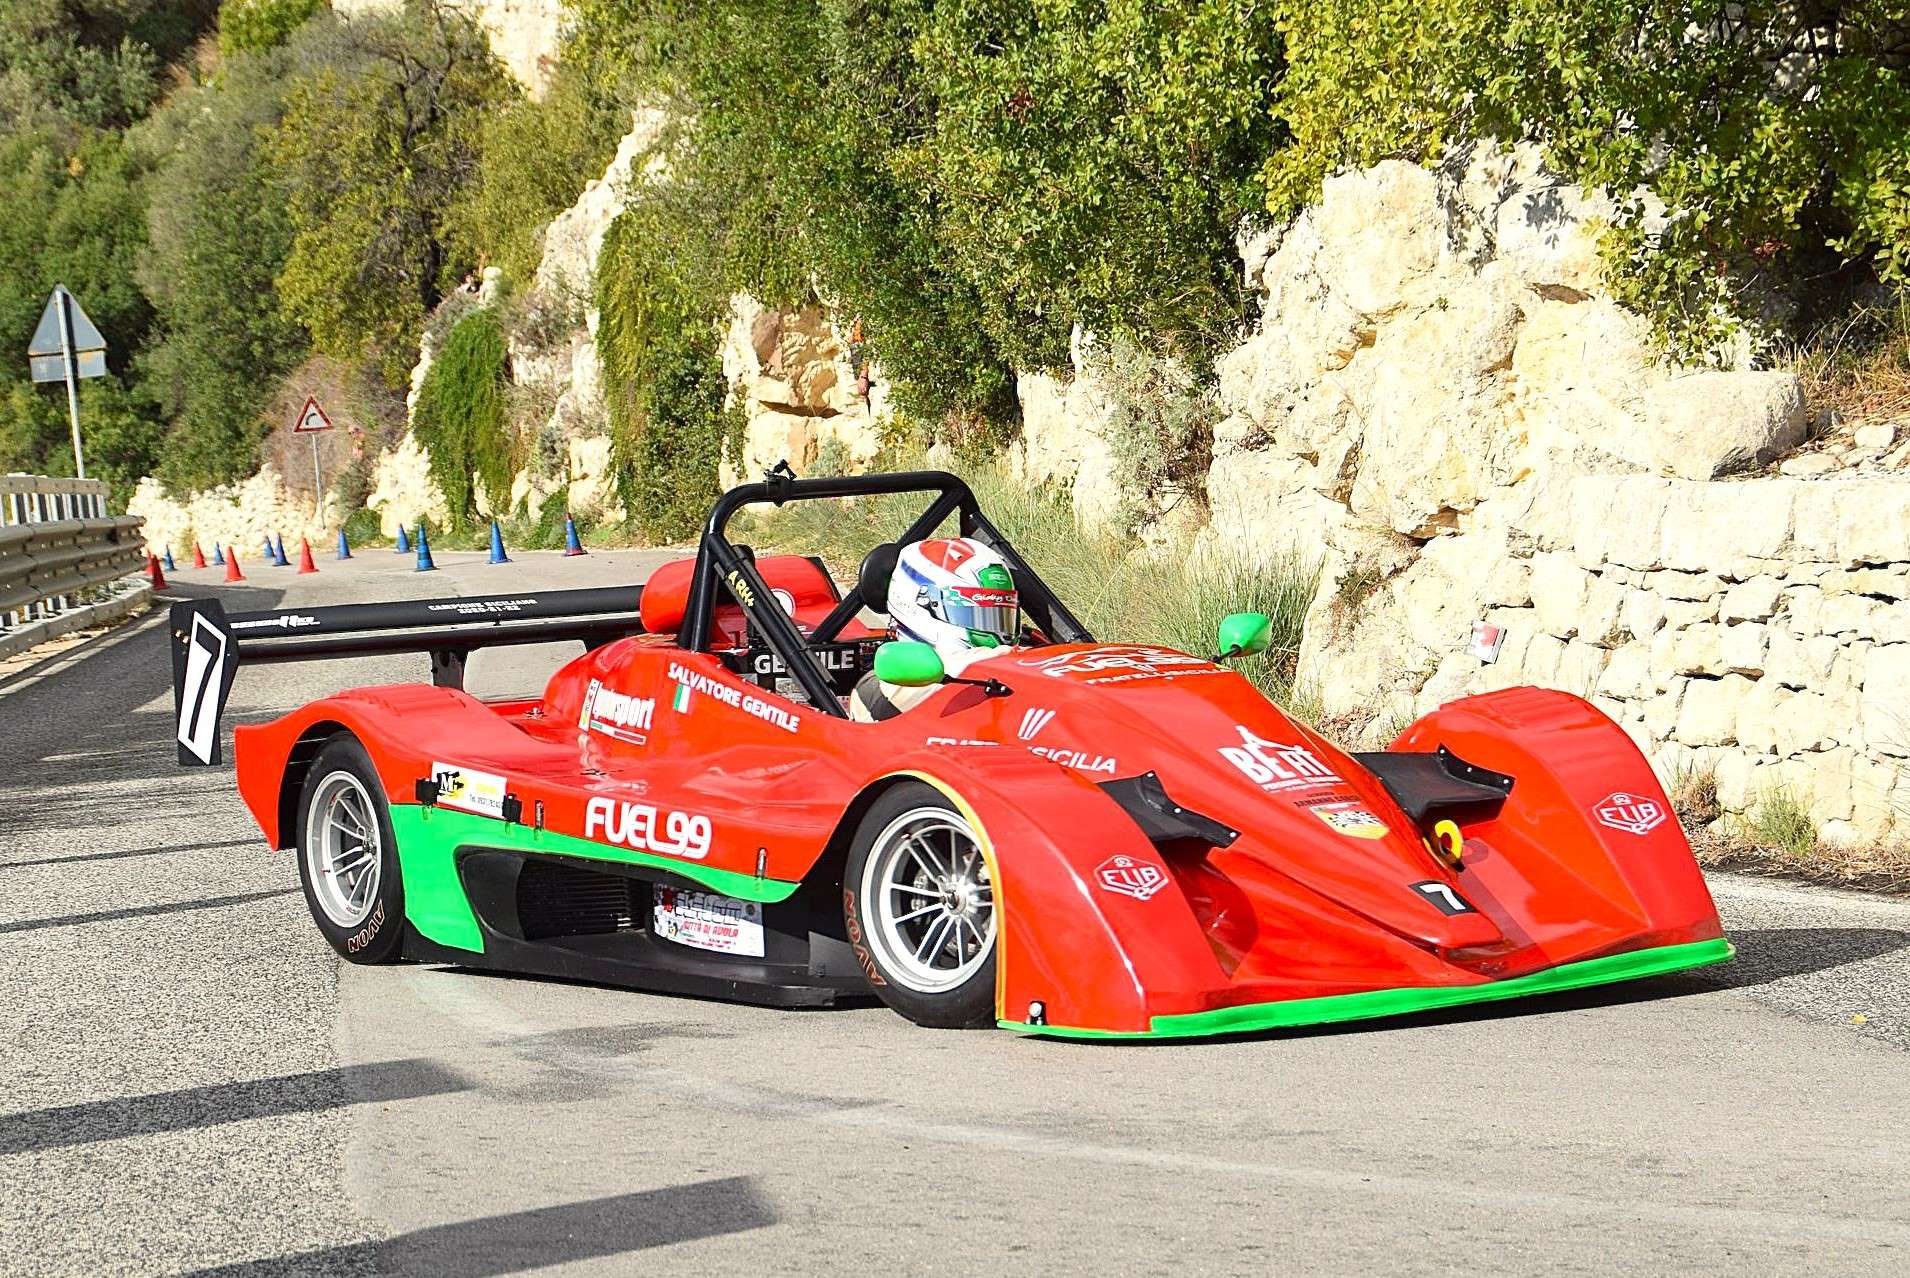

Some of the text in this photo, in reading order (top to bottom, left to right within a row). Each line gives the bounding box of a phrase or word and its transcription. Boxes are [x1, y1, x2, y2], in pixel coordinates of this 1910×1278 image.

[188, 611, 222, 743] 7
[754, 650, 855, 674] GEILE
[668, 662, 742, 708] SALVATORE
[741, 695, 800, 733] GENTILE
[1032, 747, 1116, 774] SICILIA
[585, 796, 712, 859] FUEL99
[1419, 883, 1466, 910] 7
[348, 899, 385, 953] AVON
[844, 888, 887, 985] AVON
